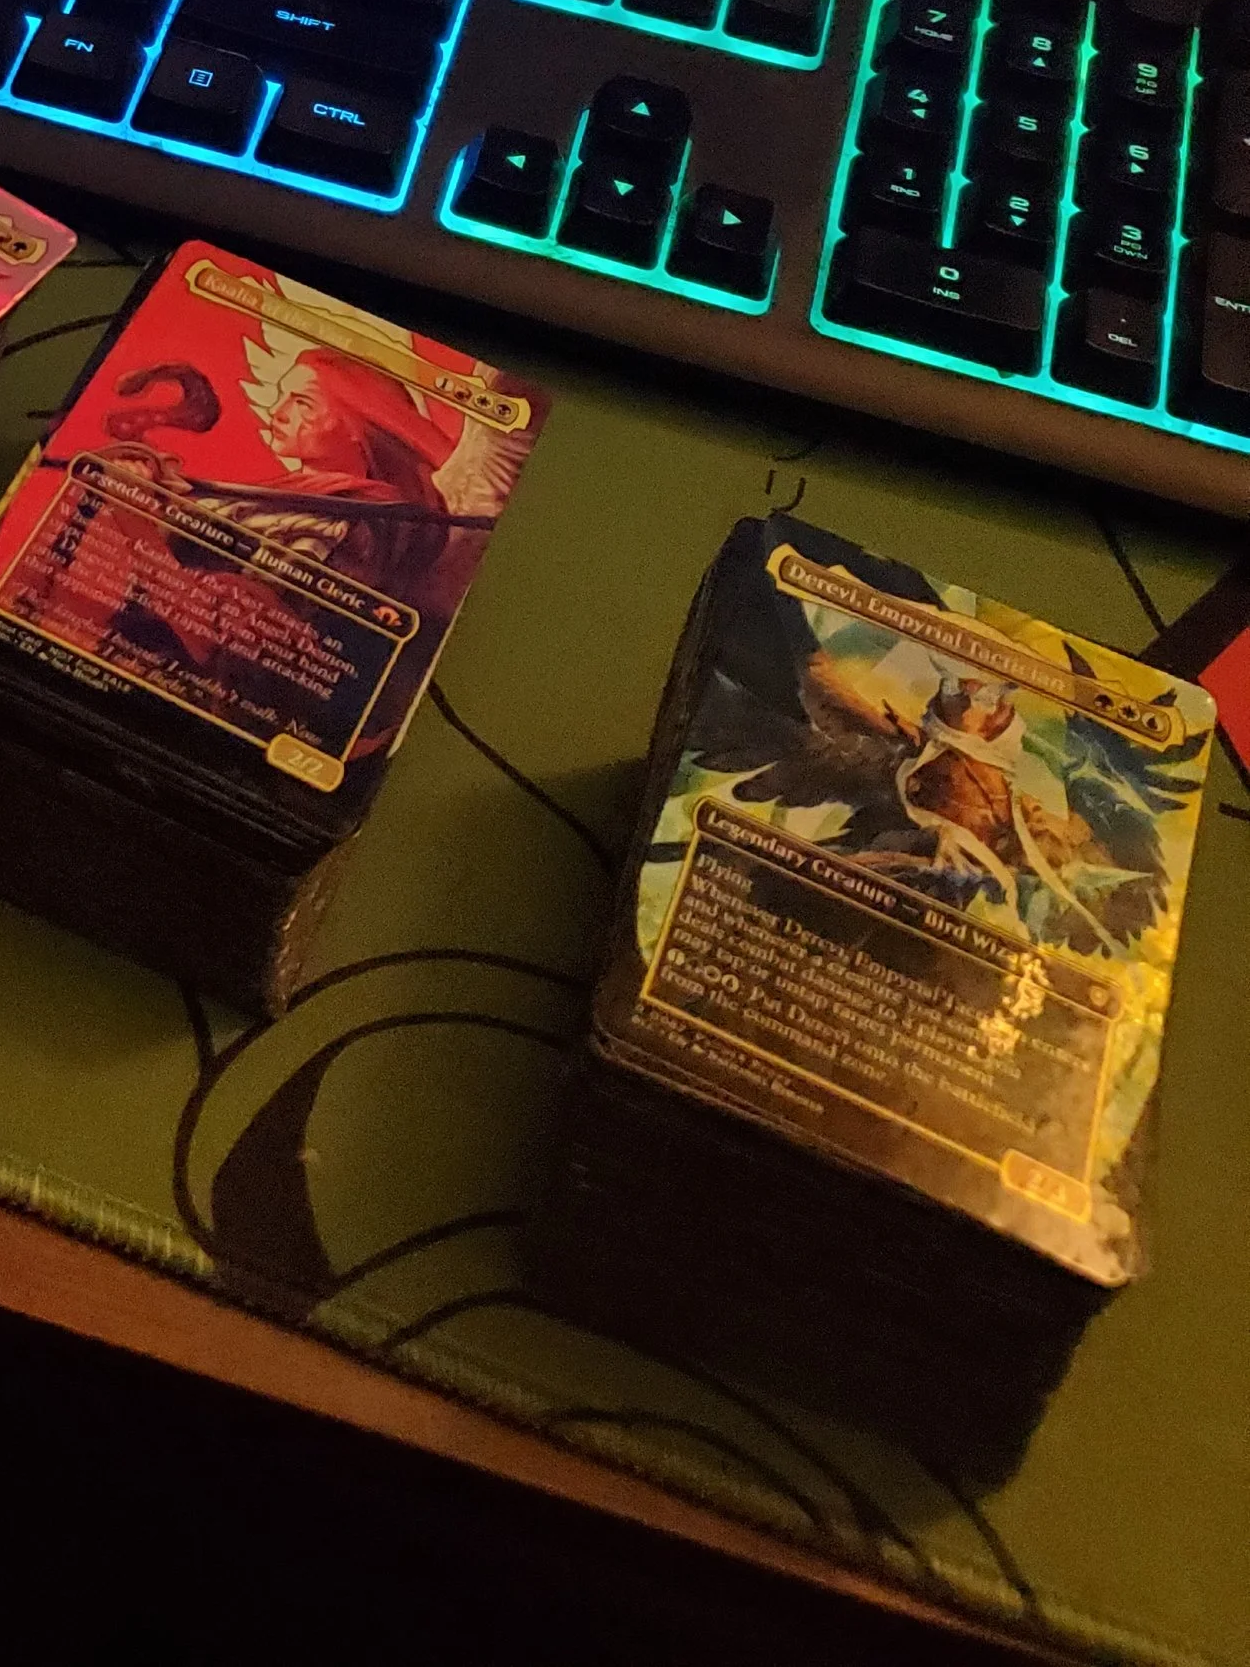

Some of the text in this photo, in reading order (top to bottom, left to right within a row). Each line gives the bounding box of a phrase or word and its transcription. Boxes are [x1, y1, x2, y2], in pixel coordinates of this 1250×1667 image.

[275, 8, 336, 32] SHIFT
[63, 38, 95, 54] FN
[312, 101, 367, 127] CTRL
[286, 747, 325, 778] 2/2
[704, 808, 809, 873] Legendary
[810, 857, 900, 912] Creature
